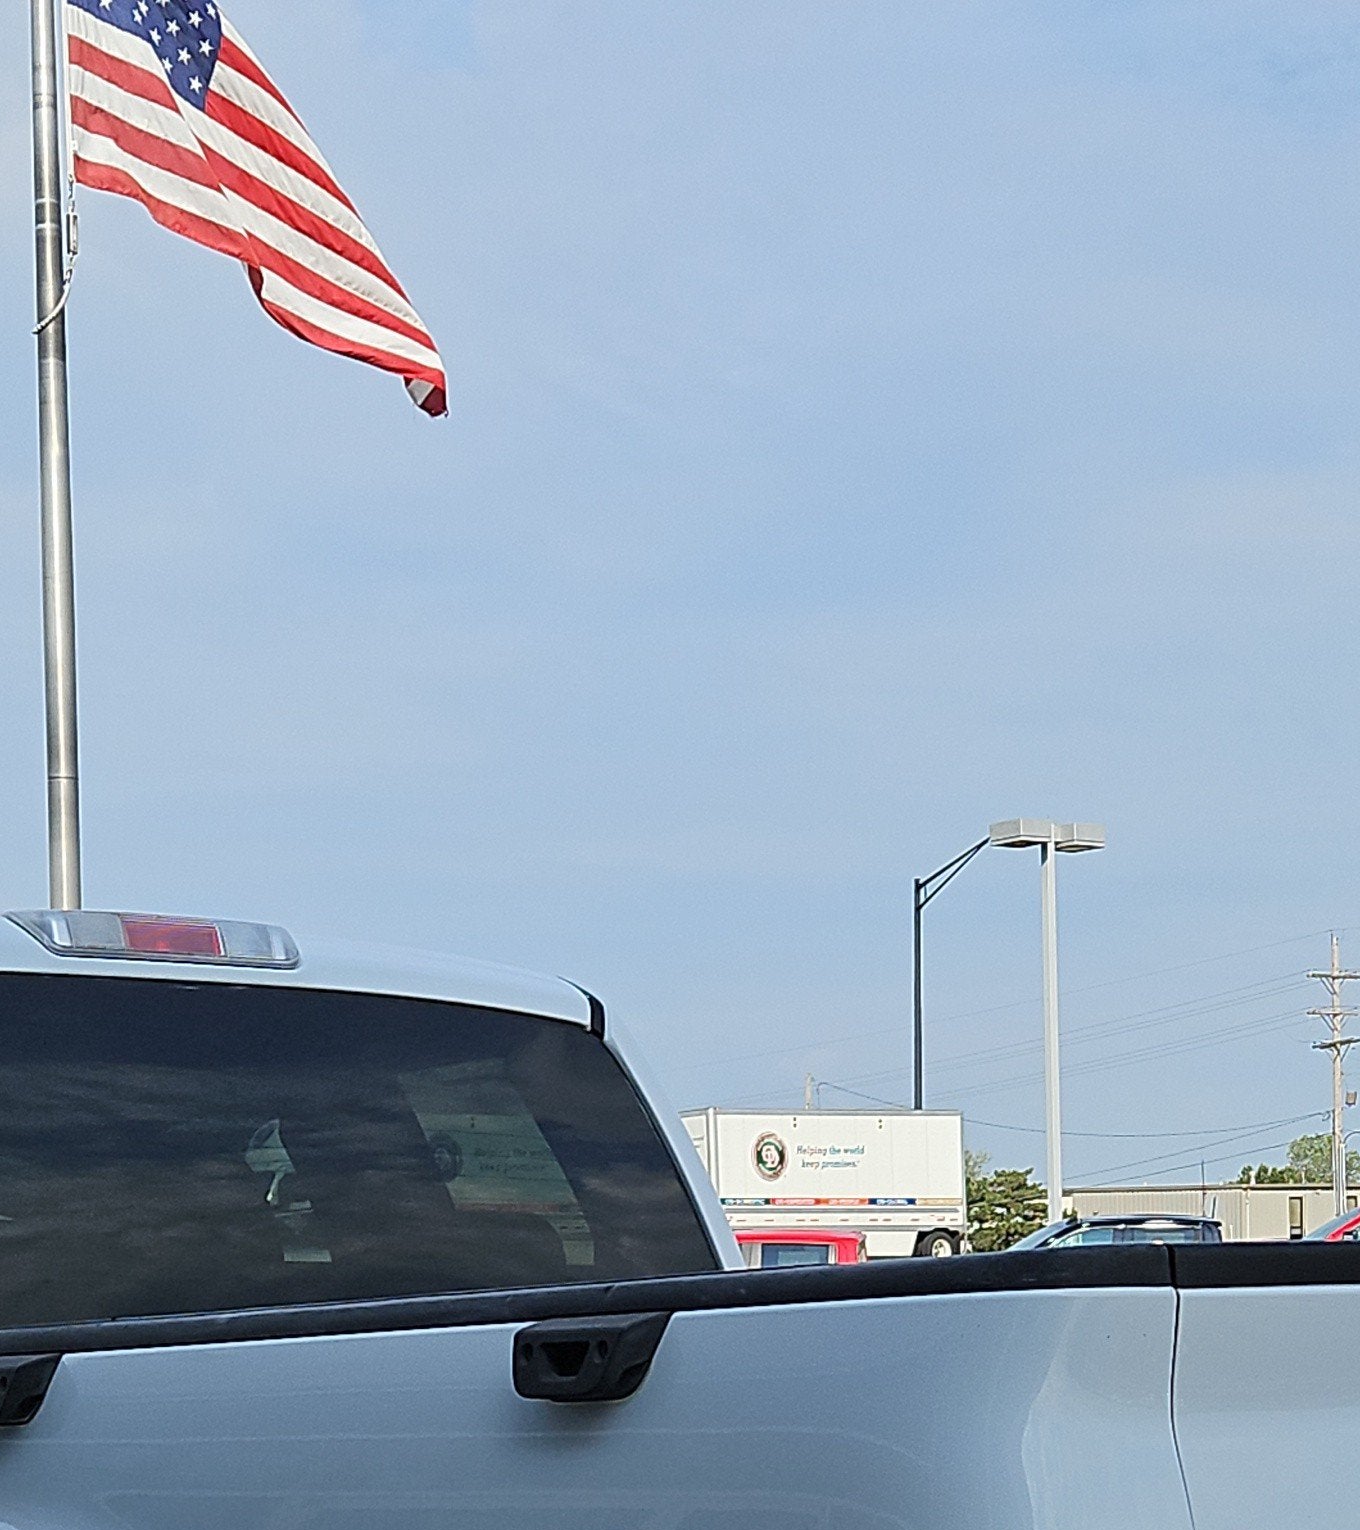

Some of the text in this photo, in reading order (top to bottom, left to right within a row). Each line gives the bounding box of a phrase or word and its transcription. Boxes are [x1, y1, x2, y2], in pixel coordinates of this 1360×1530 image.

[796, 1145, 865, 1156] Helping the world
